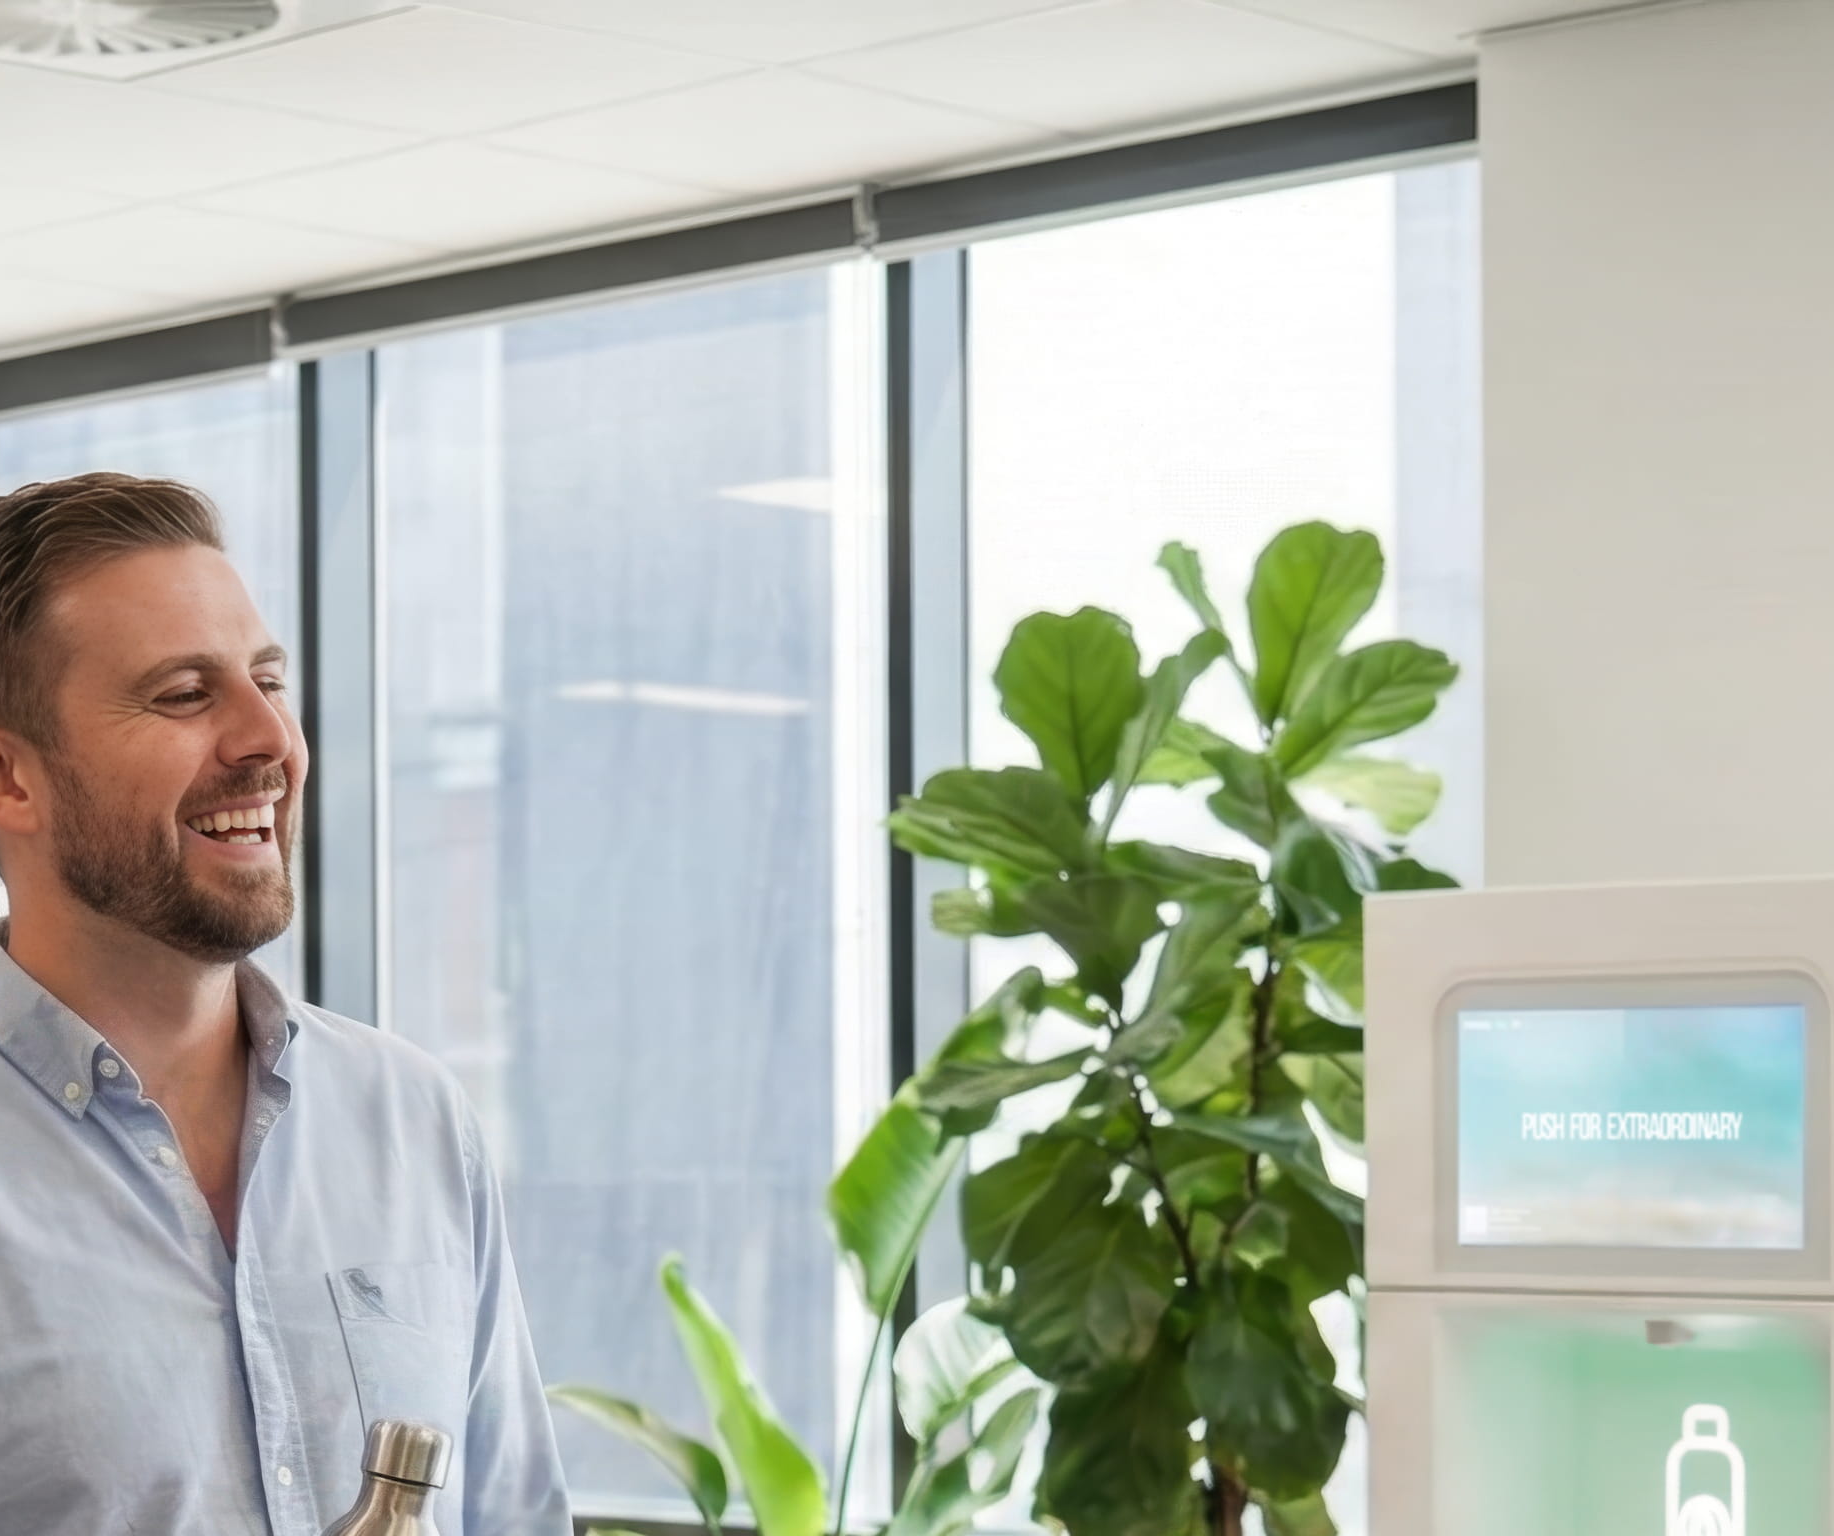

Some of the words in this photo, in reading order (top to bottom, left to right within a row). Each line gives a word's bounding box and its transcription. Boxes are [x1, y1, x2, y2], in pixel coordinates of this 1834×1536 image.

[1521, 1112, 1565, 1140] PUSH
[1569, 1112, 1602, 1140] FOR
[1606, 1112, 1743, 1140] EXTRAORDINARY
